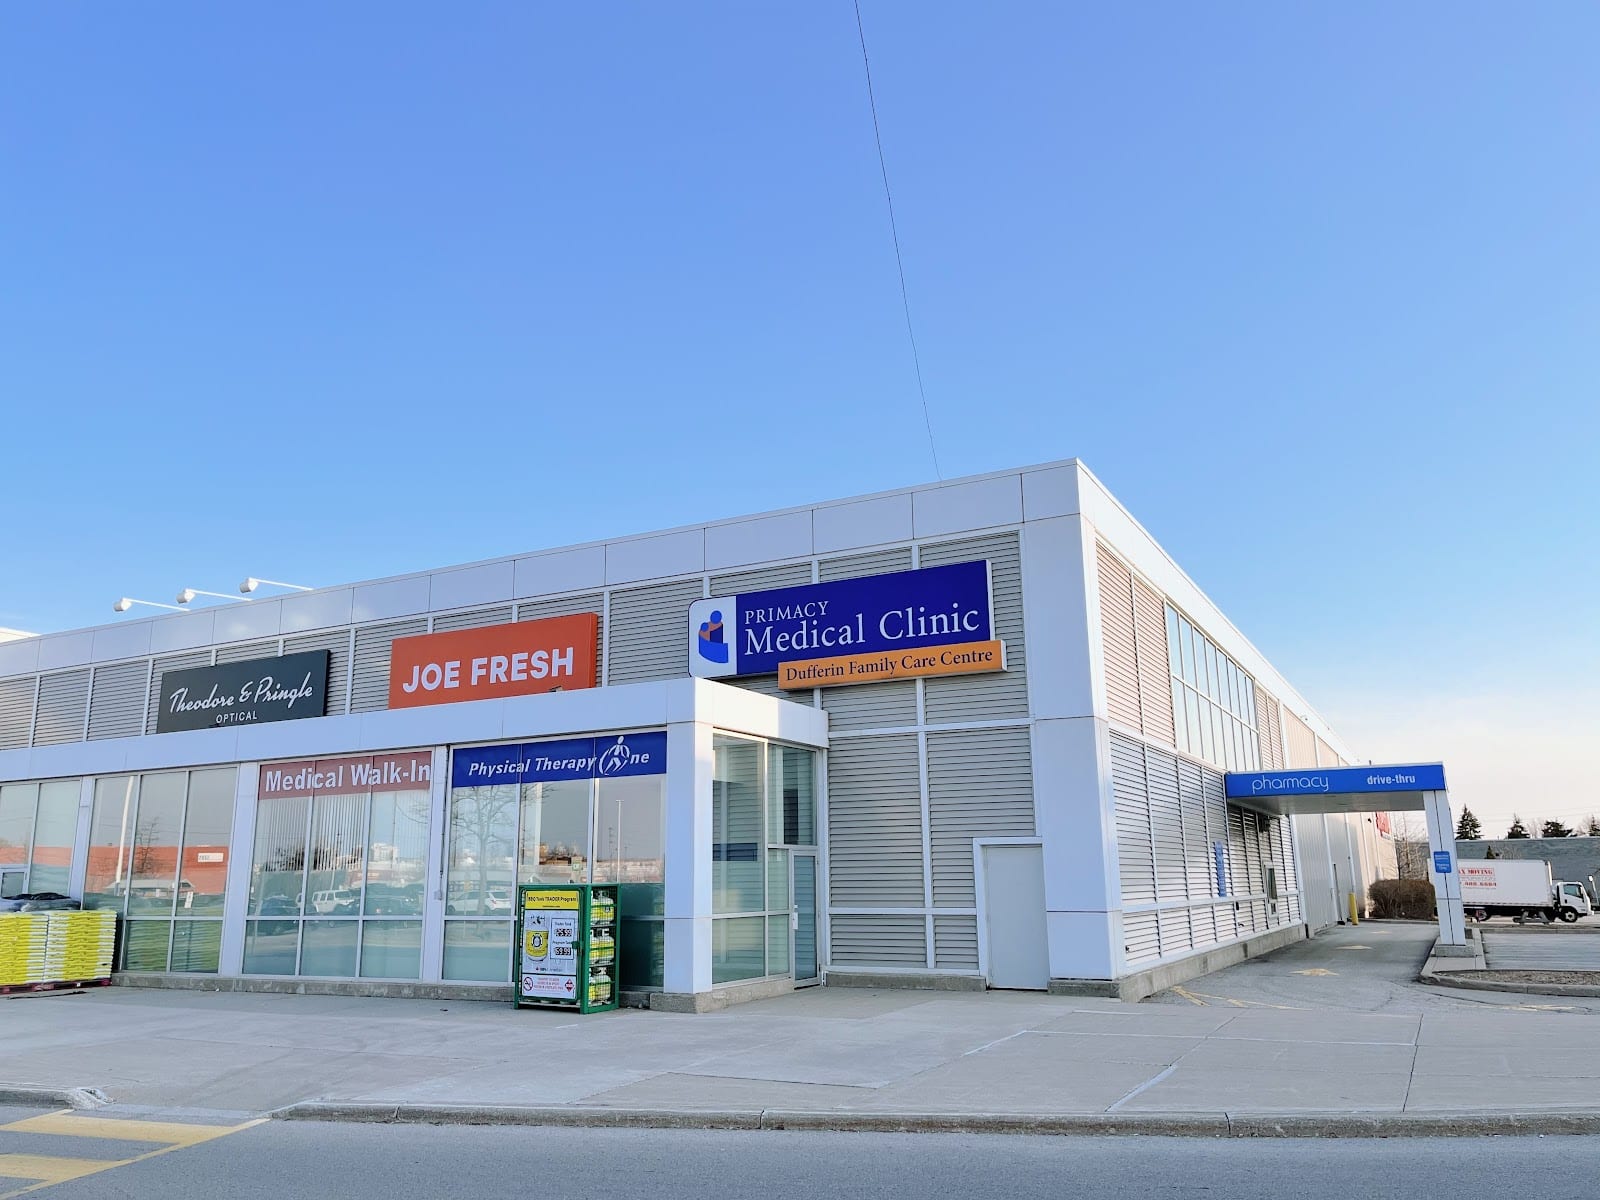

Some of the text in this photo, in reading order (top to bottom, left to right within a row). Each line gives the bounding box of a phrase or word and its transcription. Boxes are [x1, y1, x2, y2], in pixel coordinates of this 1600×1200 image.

[745, 601, 828, 624] PRIMACY
[744, 602, 980, 656] Medical Clinic
[402, 647, 574, 693] JOE FRESH
[786, 650, 993, 681] Dufferin Family Care Centre
[170, 671, 313, 713] Theodore & Pringle
[216, 710, 258, 724] OPTICAL
[265, 759, 432, 792] Medical Walk-In
[468, 759, 531, 778] Physical
[535, 755, 597, 772] Therapy
[1251, 774, 1416, 794] pharmacy drive-thru
